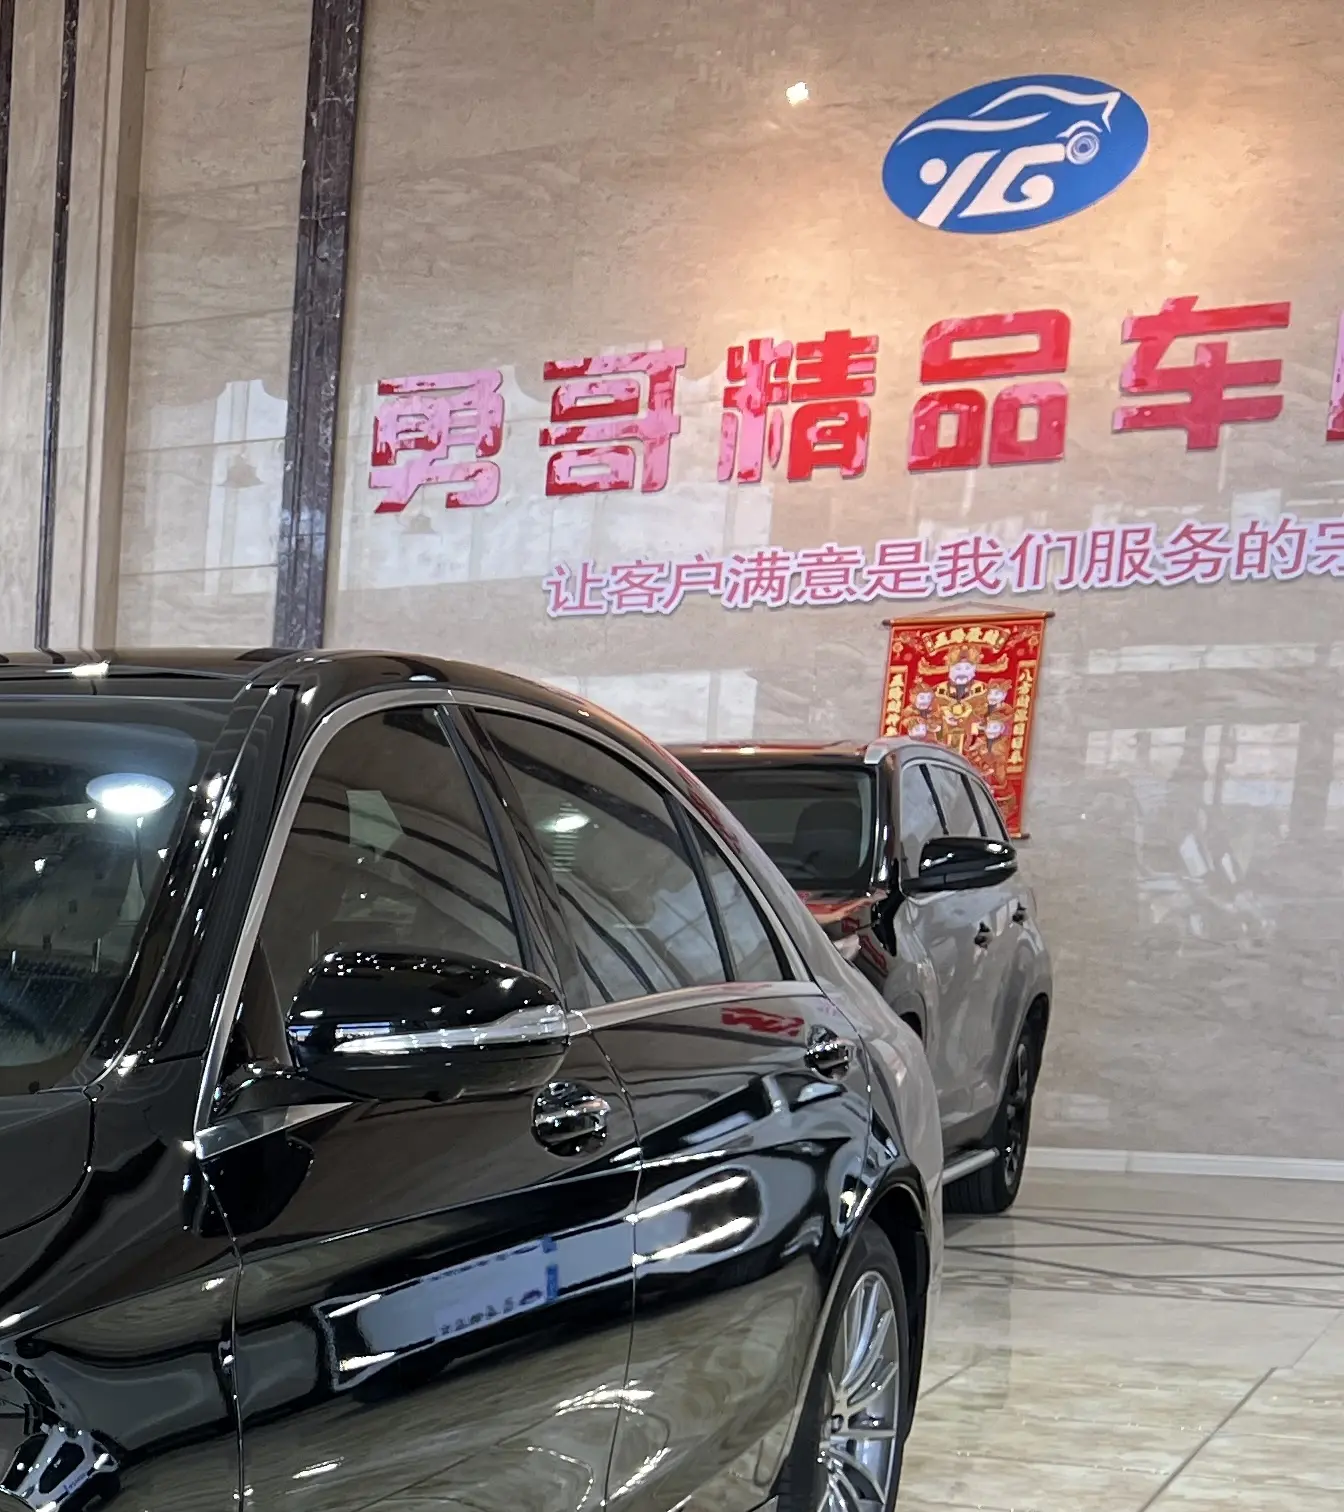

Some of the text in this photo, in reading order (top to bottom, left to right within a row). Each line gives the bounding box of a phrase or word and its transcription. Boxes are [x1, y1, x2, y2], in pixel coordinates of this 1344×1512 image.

[368, 295, 1344, 514] 勇哥精品车
